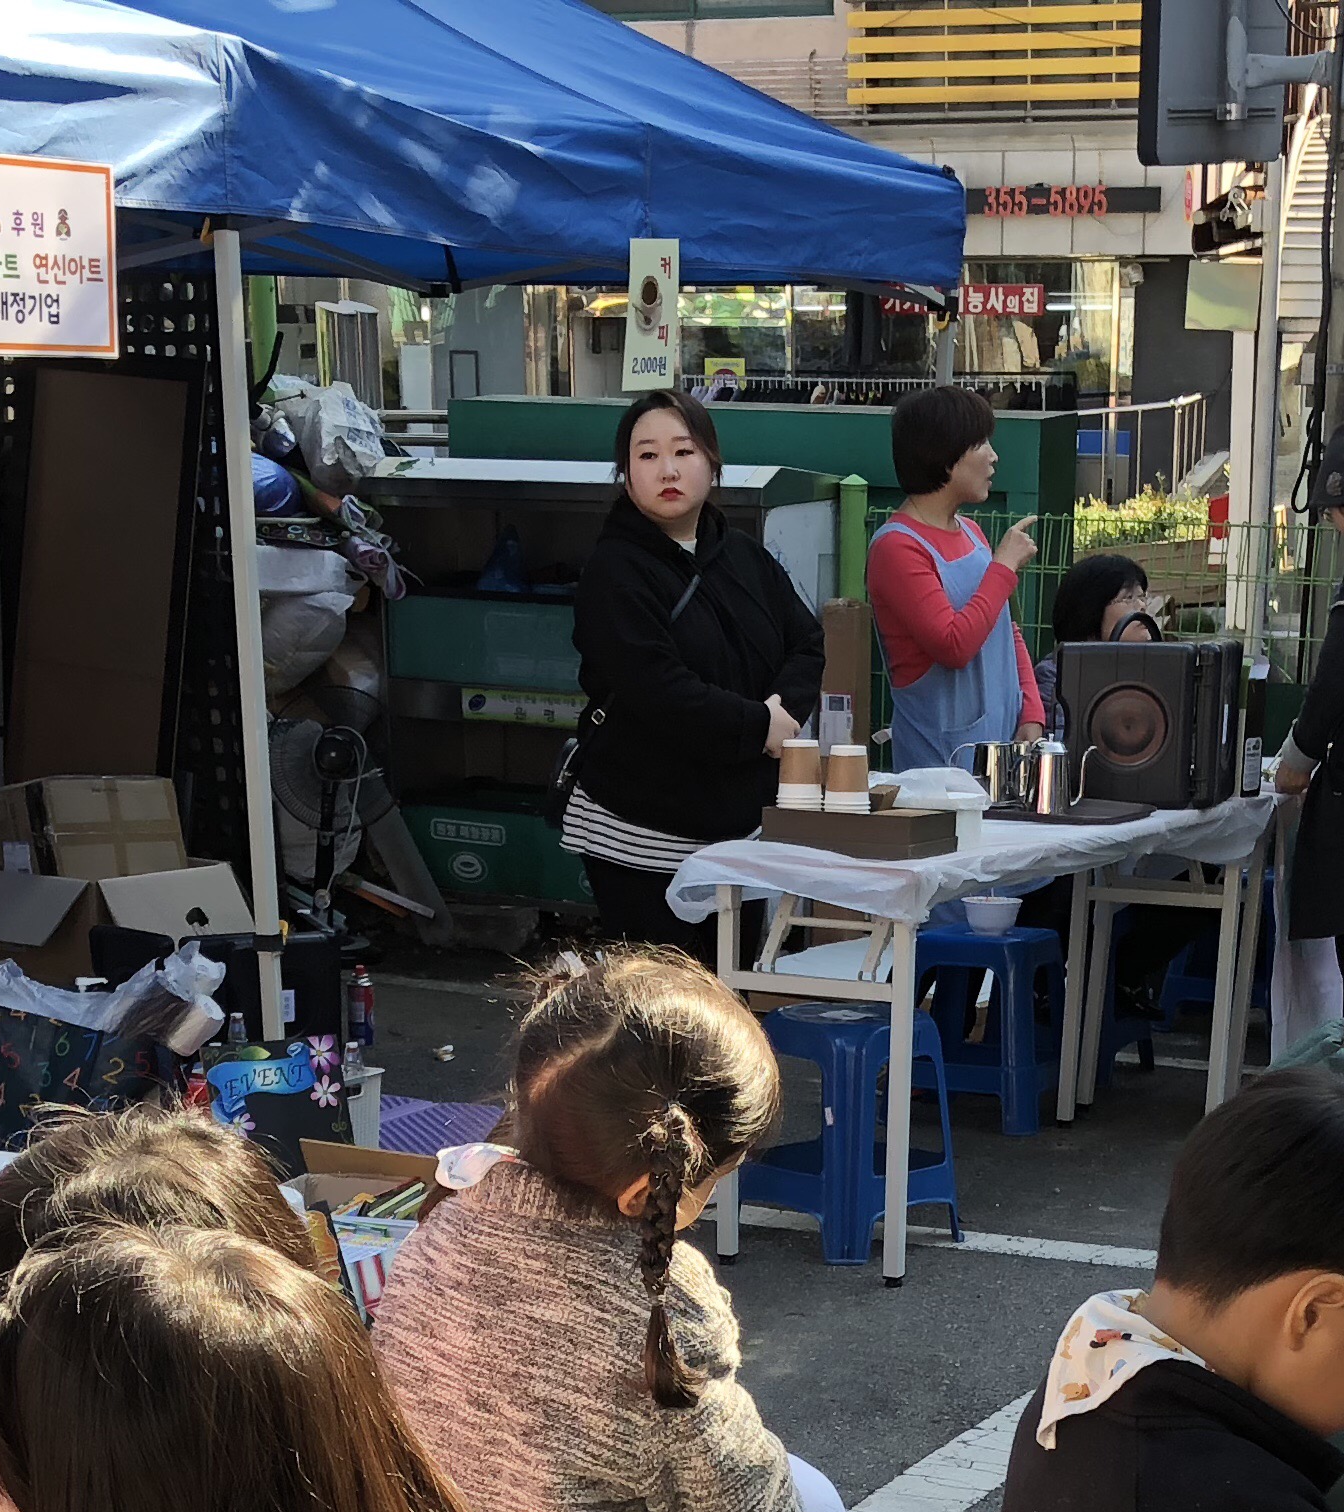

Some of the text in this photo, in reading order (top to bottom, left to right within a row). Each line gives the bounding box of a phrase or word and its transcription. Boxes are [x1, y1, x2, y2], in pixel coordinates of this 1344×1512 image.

[984, 184, 1108, 218] 355-5895
[32, 252, 104, 285] 연신아트
[631, 356, 667, 377] 2,000원
[224, 1063, 308, 1098] EVENT
